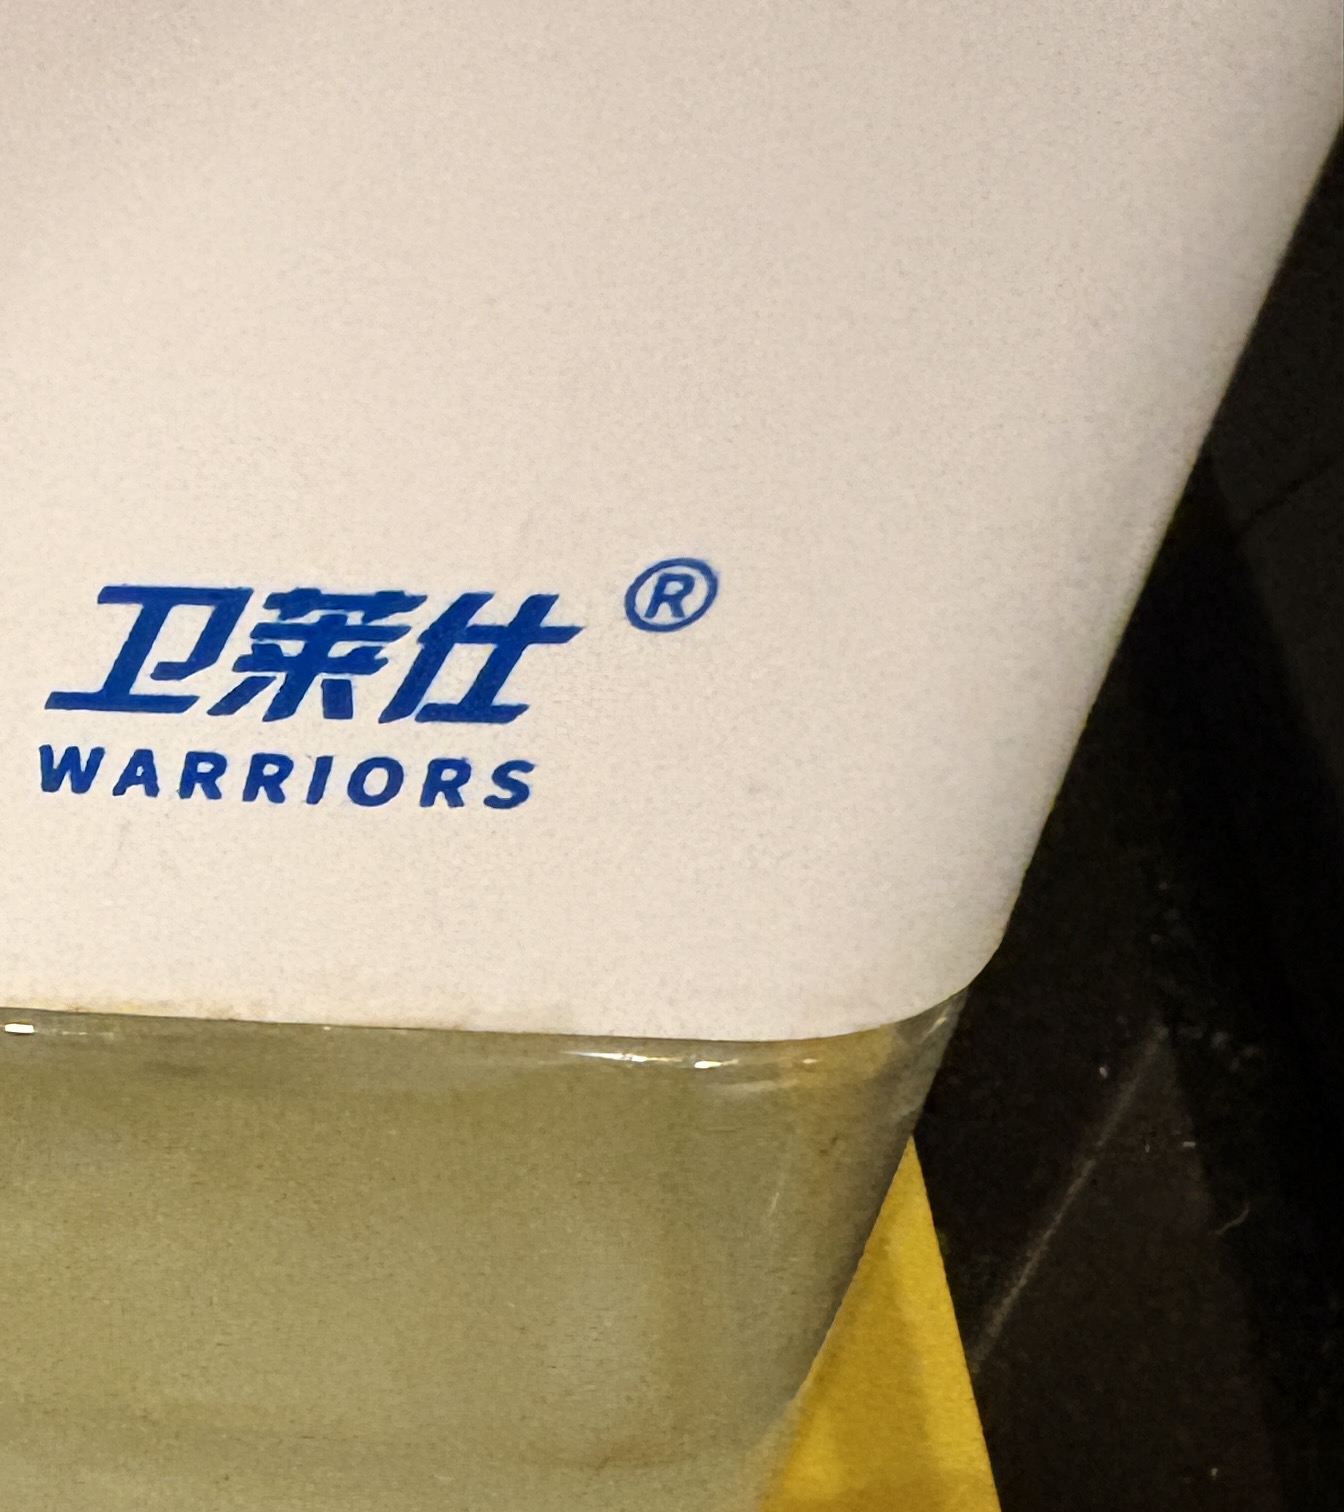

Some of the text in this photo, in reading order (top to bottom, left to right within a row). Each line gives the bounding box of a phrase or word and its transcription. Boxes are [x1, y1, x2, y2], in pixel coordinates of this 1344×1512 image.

[45, 585, 584, 723] 卫莱仕
[38, 744, 535, 809] WARRIORS
